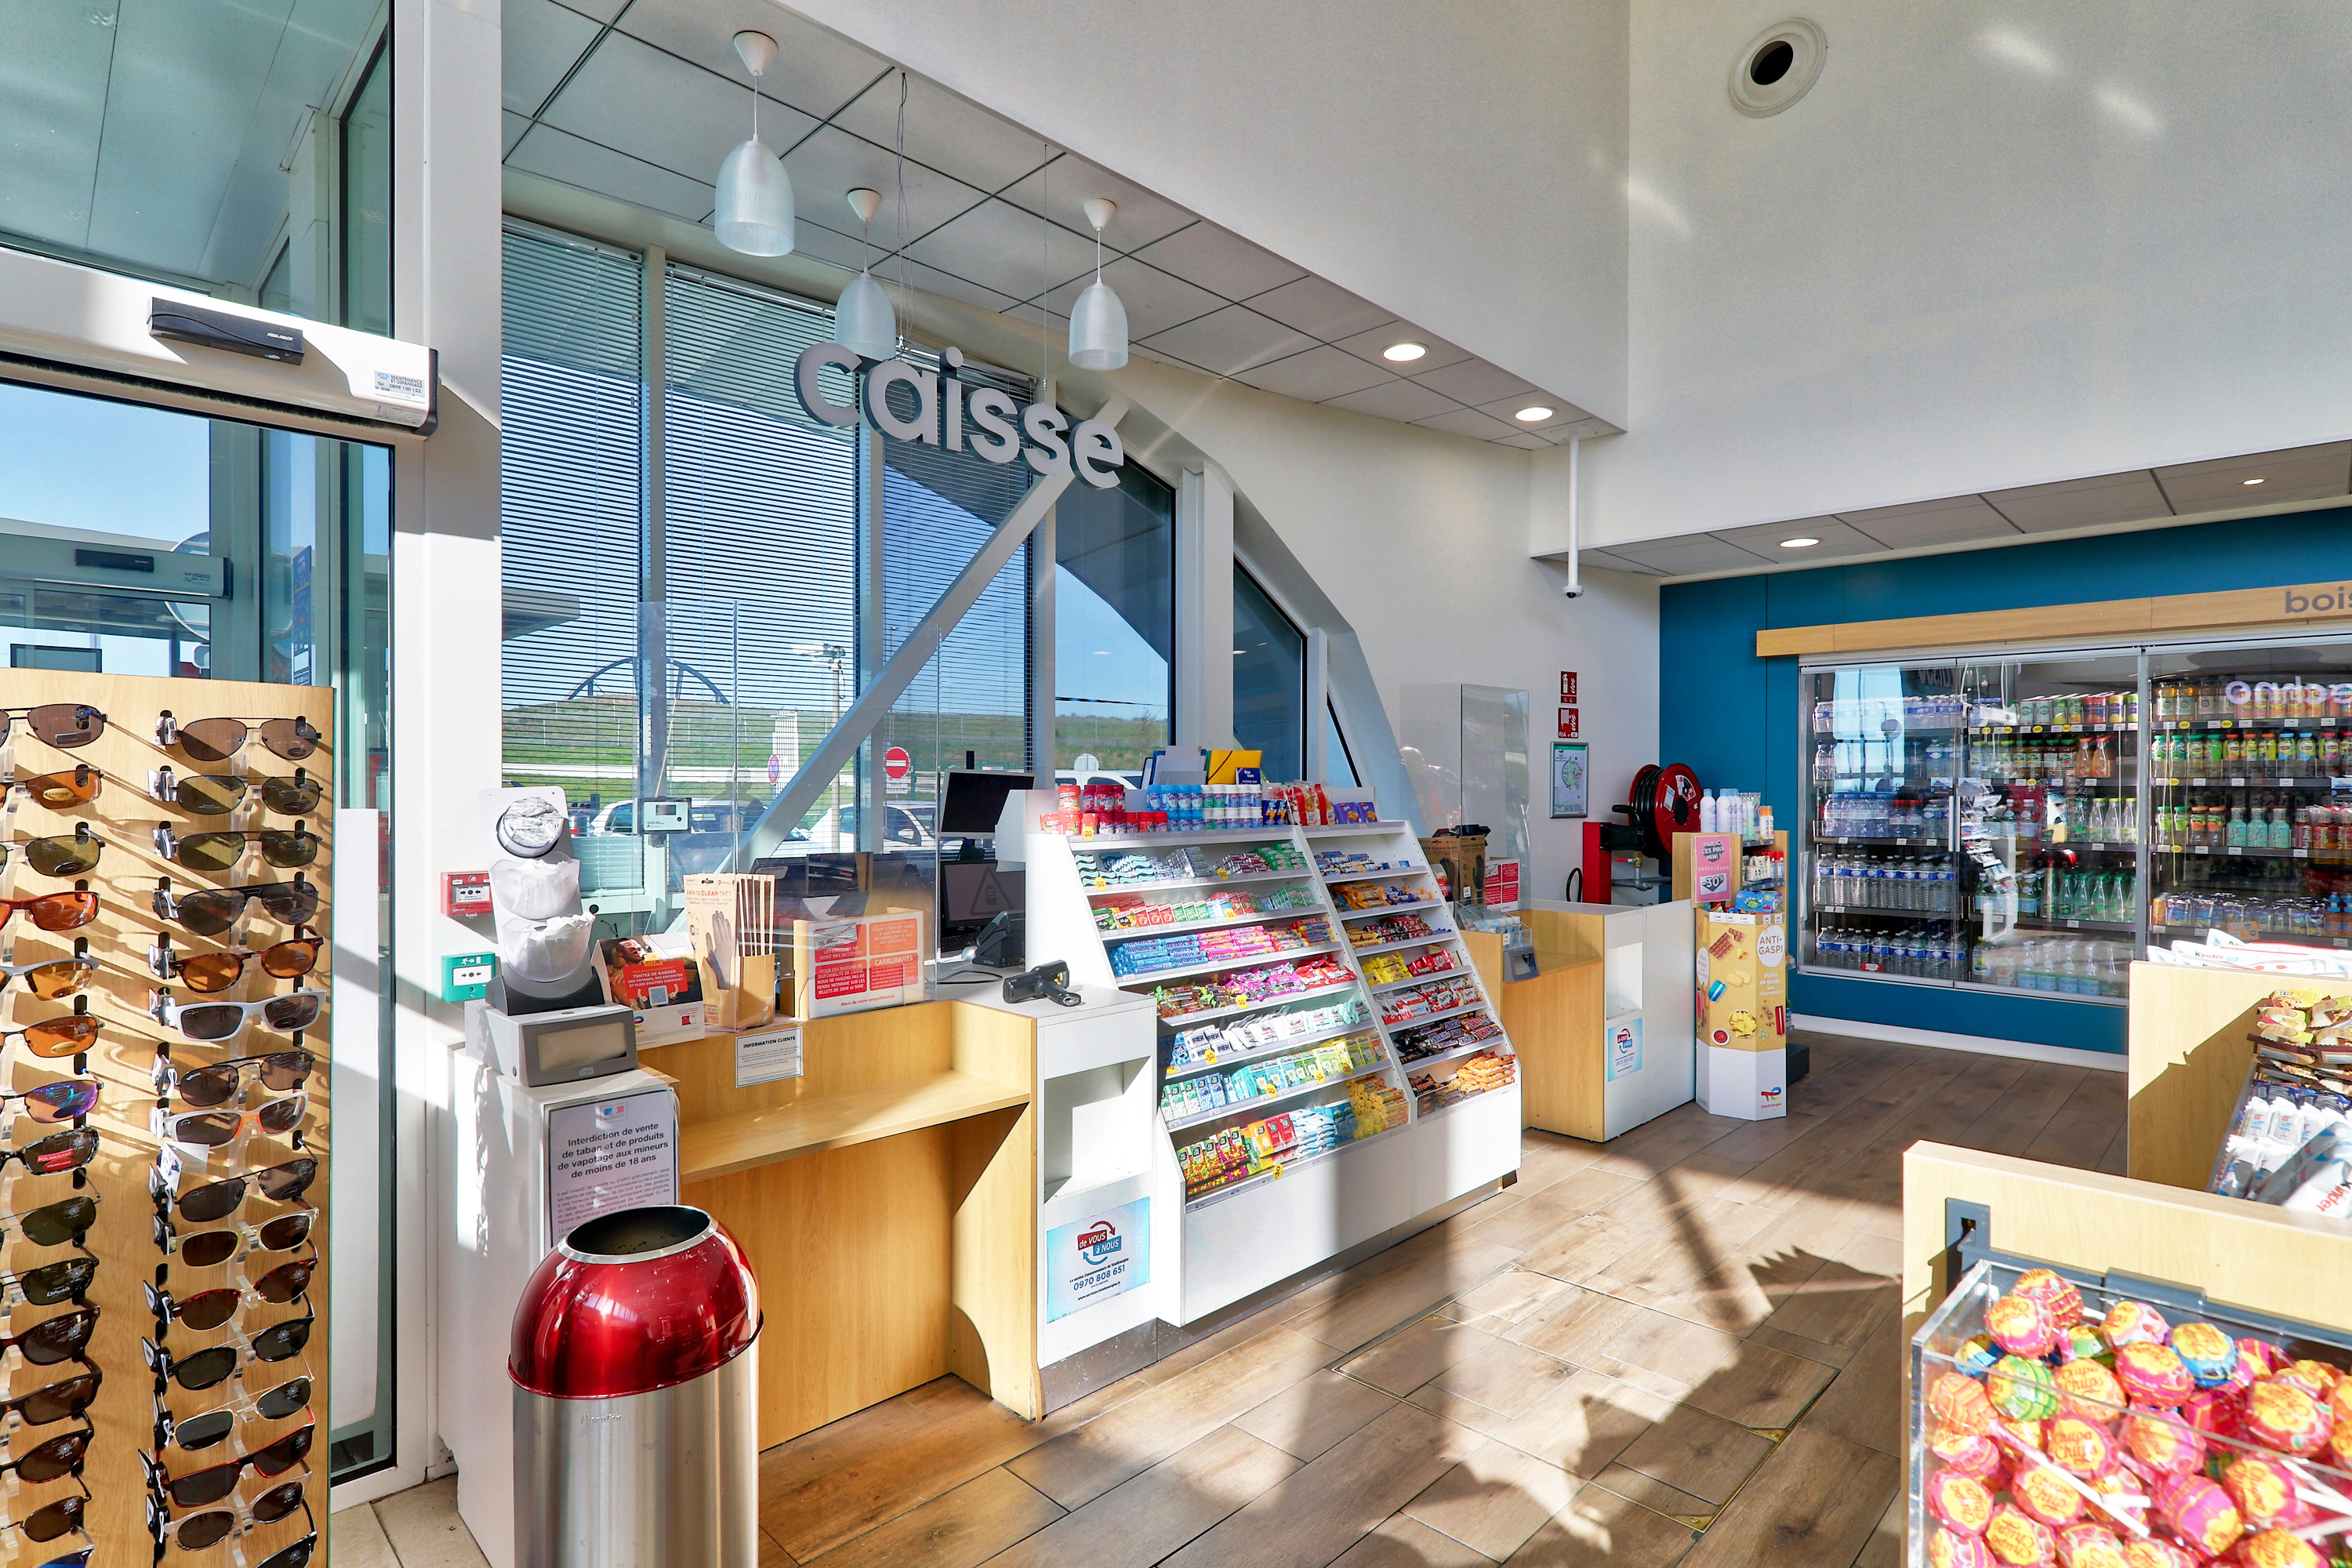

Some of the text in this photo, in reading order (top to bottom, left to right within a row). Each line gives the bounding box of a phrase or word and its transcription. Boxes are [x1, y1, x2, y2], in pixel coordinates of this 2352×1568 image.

[793, 342, 1124, 489] caisse
[2285, 586, 2352, 614] boi
[1702, 874, 1725, 887] -30%
[1759, 946, 1783, 955] GASPI
[875, 955, 913, 966] CARBURANTS
[868, 994, 895, 1003] compréhension
[743, 1039, 776, 1048] INFORMATION
[1192, 1034, 1204, 1044] FRISK
[1429, 1032, 1450, 1044] SNICKERS
[568, 1131, 619, 1147] Interdiction
[635, 1123, 659, 1133] vente
[562, 1150, 574, 1159] de
[576, 1145, 602, 1156] tabac
[629, 1131, 664, 1146] produits
[38, 1152, 71, 1161] POLARISANT
[557, 1142, 669, 1171] de vapotage aux mineurs
[572, 1170, 583, 1178] de
[585, 1164, 612, 1175] moins
[641, 1155, 656, 1163] ans
[1080, 1232, 1106, 1248] de VOUS
[1101, 1239, 1119, 1252] NOUS
[1111, 1258, 1129, 1268] TotalEnergies
[1074, 1277, 1094, 1290] 0970
[1096, 1272, 1111, 1282] 808
[1113, 1265, 1125, 1275] 651
